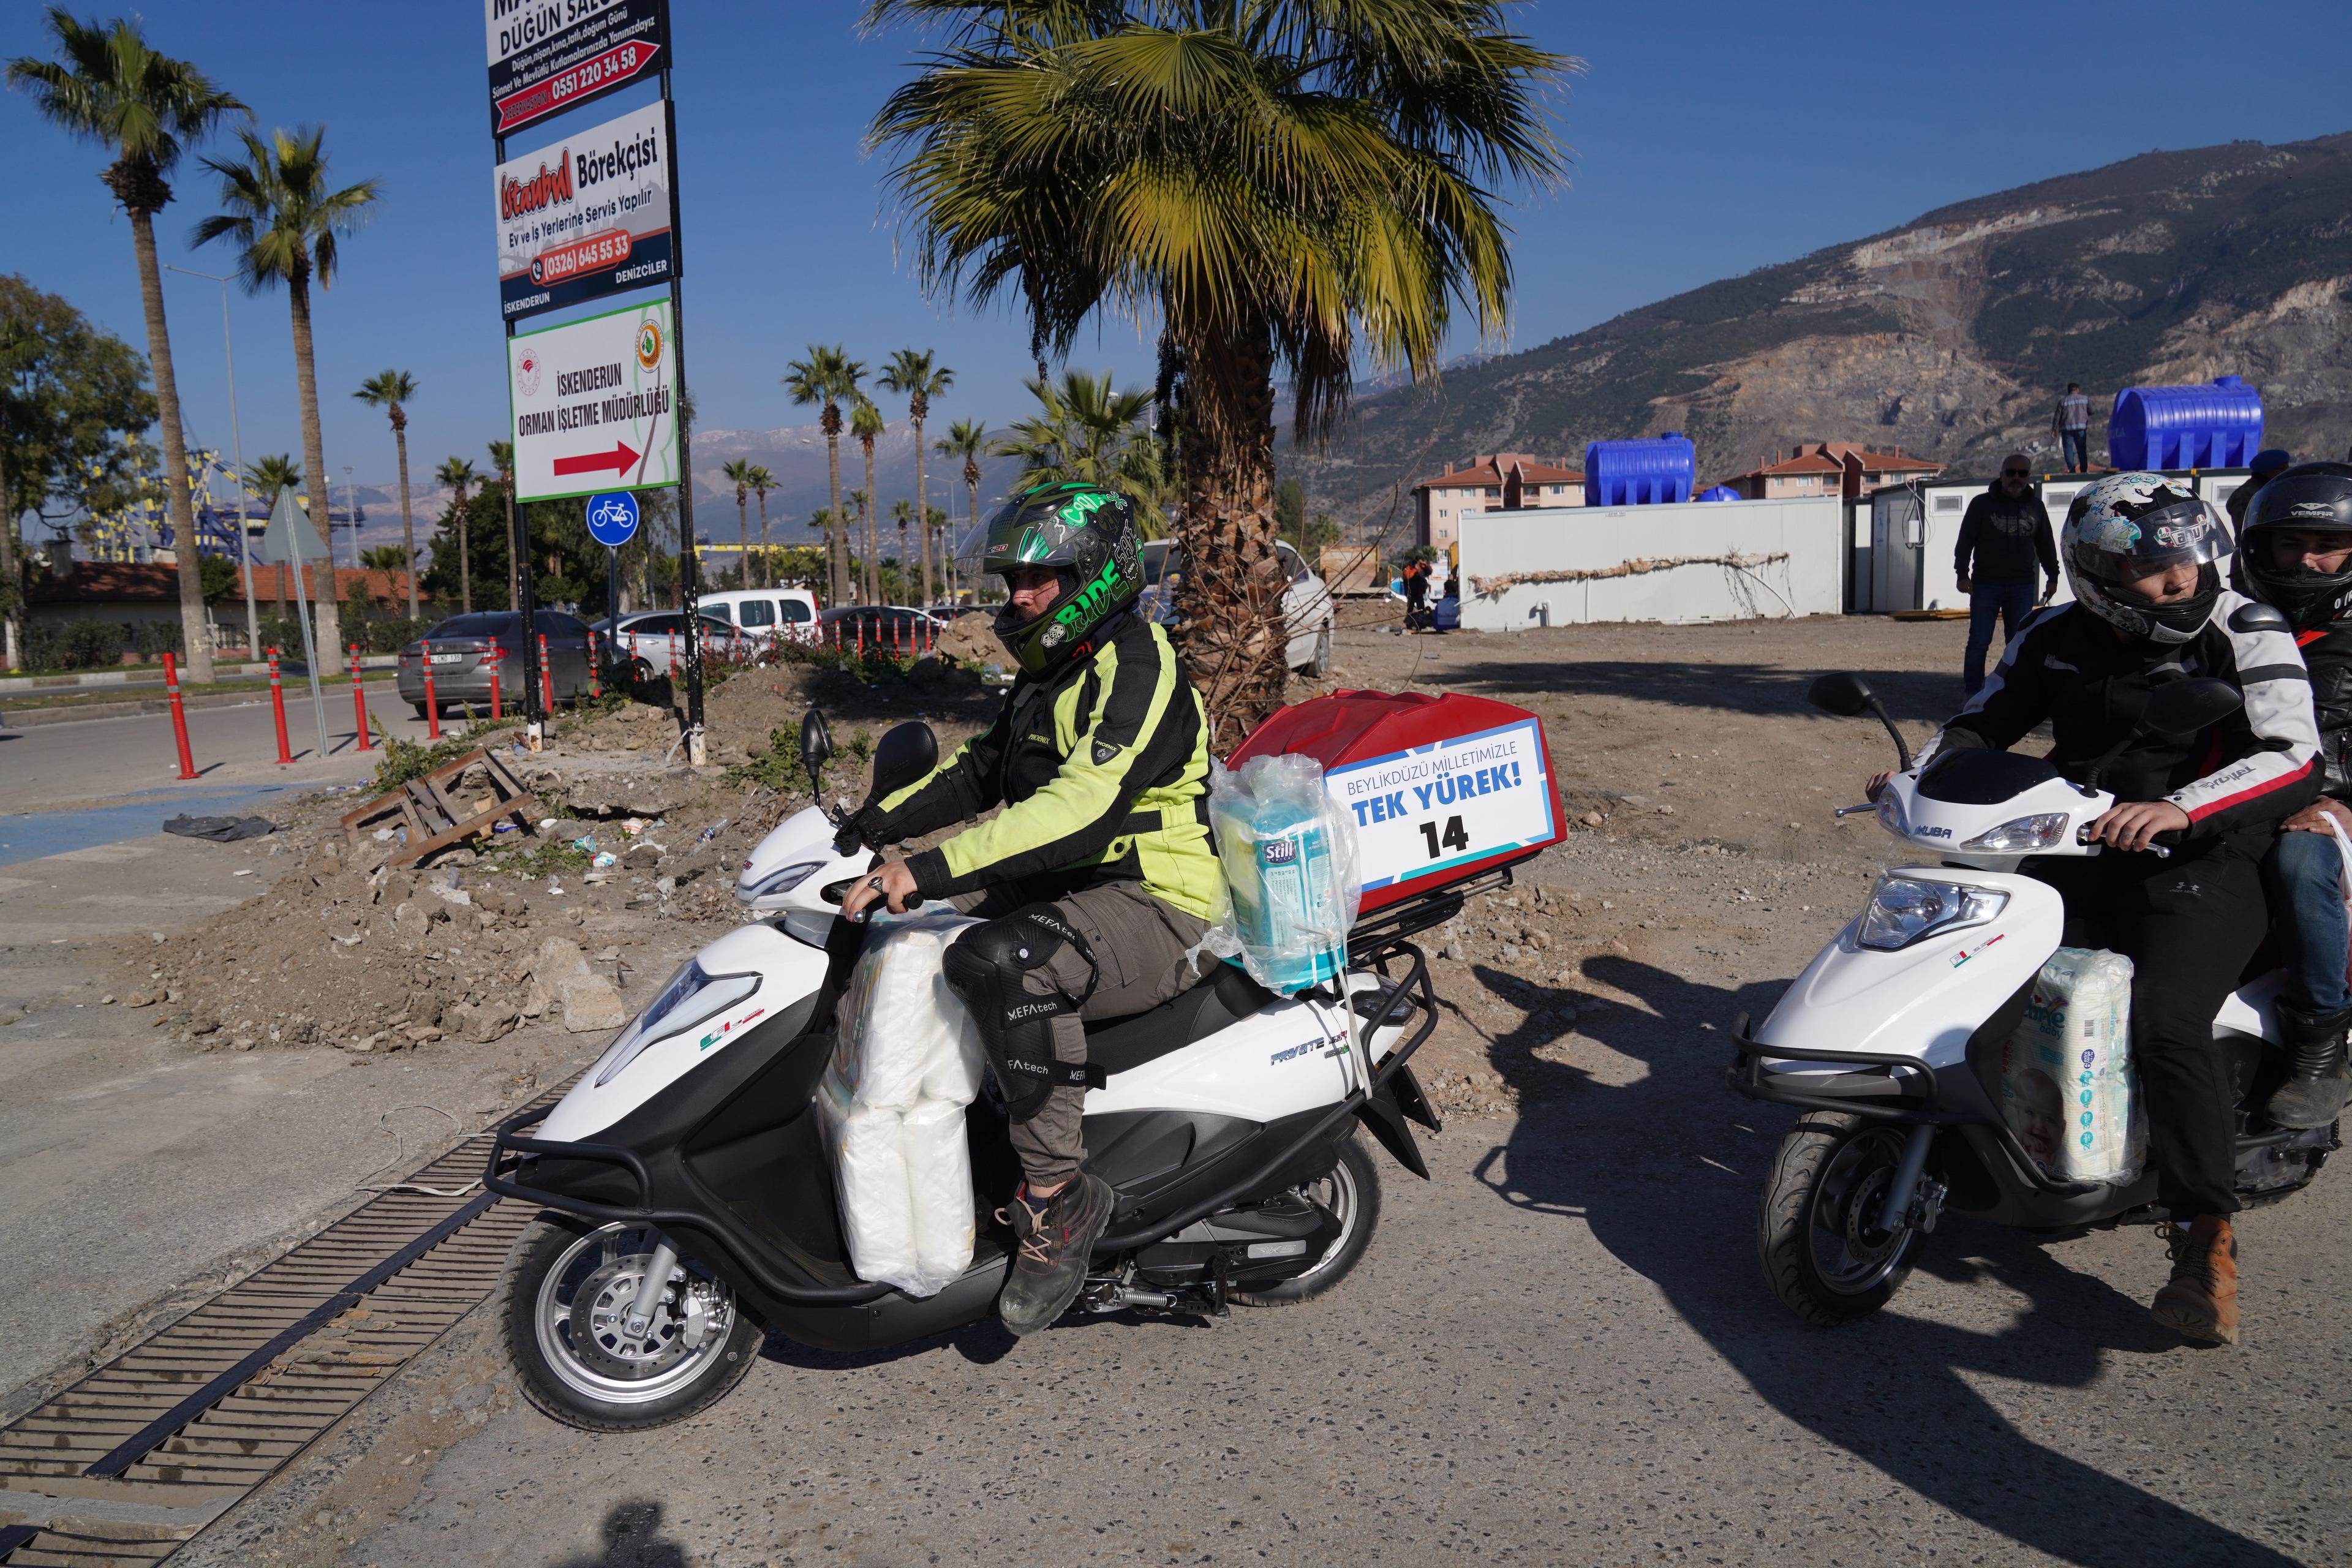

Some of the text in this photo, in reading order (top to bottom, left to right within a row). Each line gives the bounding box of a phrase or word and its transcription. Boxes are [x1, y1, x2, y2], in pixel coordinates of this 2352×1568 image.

[500, 0, 615, 56] DÜĞÜN SAL
[608, 6, 628, 26] Günü
[492, 16, 655, 99] Sünnet Ve Mevlütlü Kutlamalarınızda Yanınızdayız
[552, 72, 578, 100] 0551
[579, 64, 601, 89] 220
[603, 56, 619, 77] 34
[620, 46, 636, 70] 58
[576, 127, 657, 189] Börekçisi
[509, 188, 652, 247] Ev ve İş Yerlerine Servis Yapılır
[544, 235, 628, 279] (0326) 645 55 33
[616, 259, 667, 284] DENİZCİLER
[504, 291, 550, 314] İSKENDERUN
[557, 362, 622, 397] İSKENDERUN
[519, 385, 669, 437] ORMAN İŞLETME MÜDÜRLÜĞÜ
[1055, 559, 1130, 642] RIDE
[1028, 734, 1050, 745] PHOENIX
[1095, 740, 1117, 752] PHOENIX
[1348, 741, 1517, 796] BEYLİKDÜZÜ MİLLETİMİZLE
[1351, 761, 1521, 827] TEK YÜREK!
[1419, 815, 1469, 859] 14
[1917, 825, 1953, 839] KUBA
[1266, 842, 1293, 859] Still
[1028, 913, 1076, 940] MEFAtec
[700, 1022, 730, 1047] EFI
[2040, 1022, 2064, 1040] baby
[1008, 1059, 1049, 1075] FAtech
